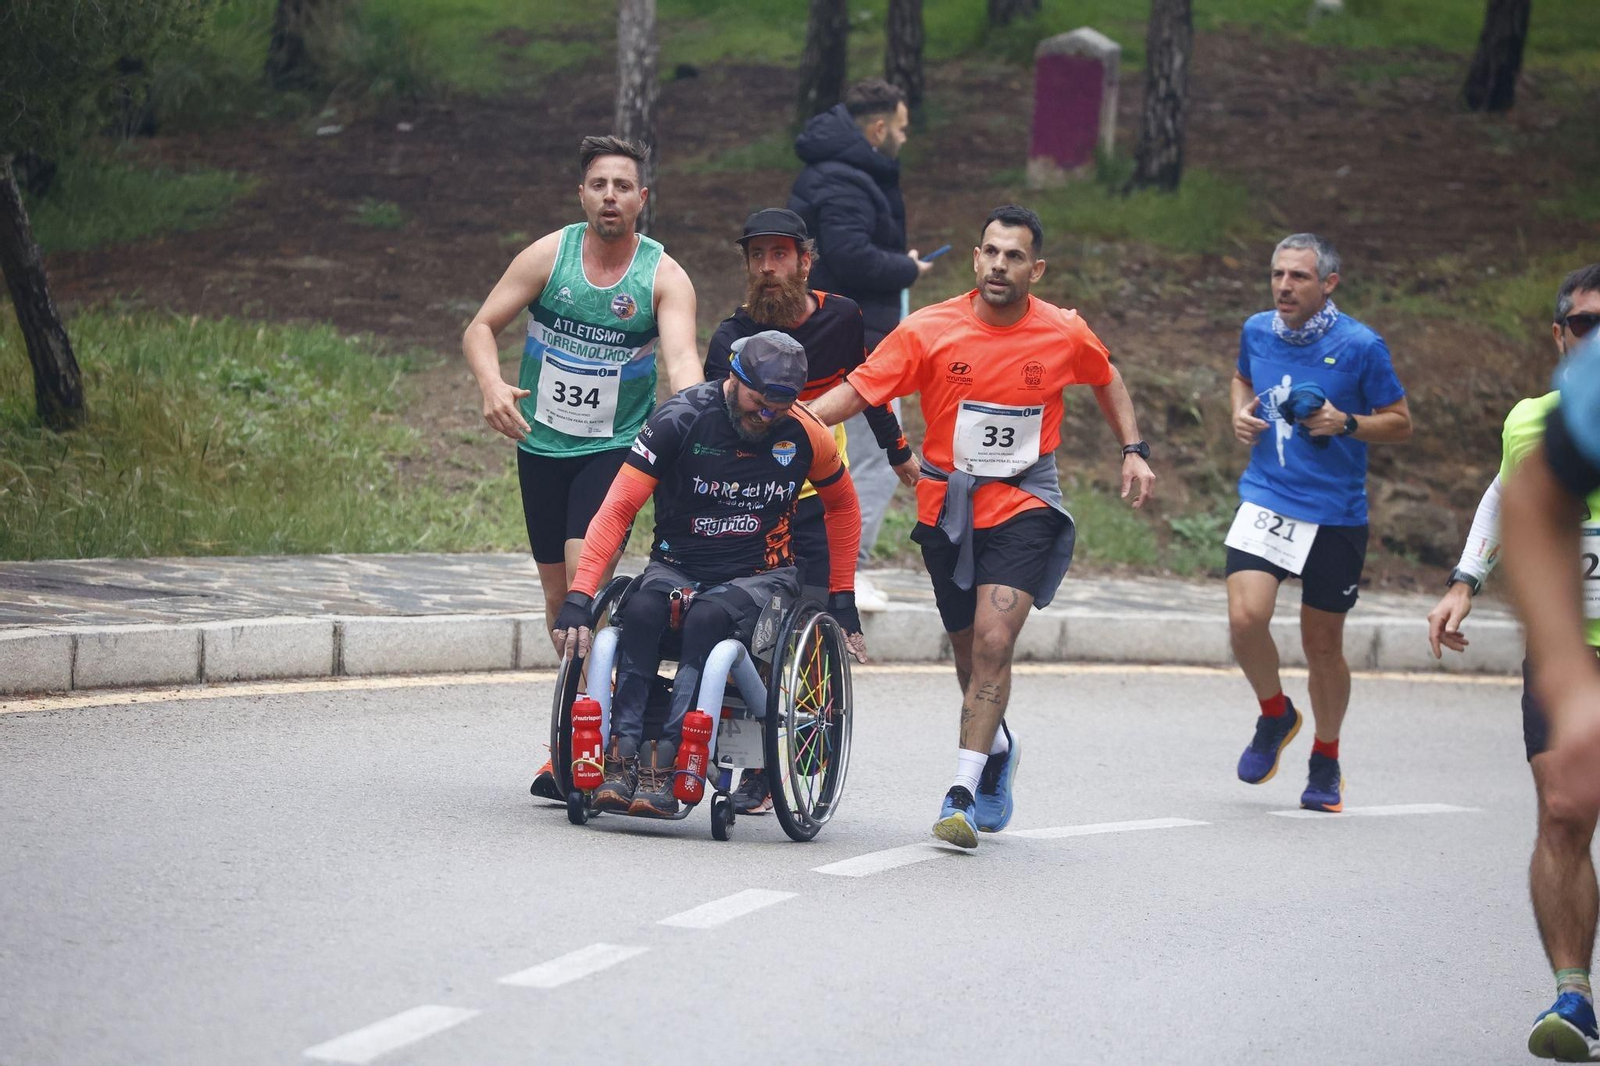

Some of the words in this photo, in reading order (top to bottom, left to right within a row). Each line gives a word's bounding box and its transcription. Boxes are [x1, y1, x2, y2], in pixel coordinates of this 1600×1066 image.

[553, 318, 626, 345] ATLETISMO
[542, 329, 634, 362] TORREMOLINOS
[945, 375, 974, 383] HYUNDAI
[552, 381, 601, 409] 334
[982, 426, 1015, 448] 33
[741, 483, 760, 498] del
[764, 480, 796, 505] MAR
[694, 514, 759, 536] Sigfrido
[1253, 511, 1298, 543] 821
